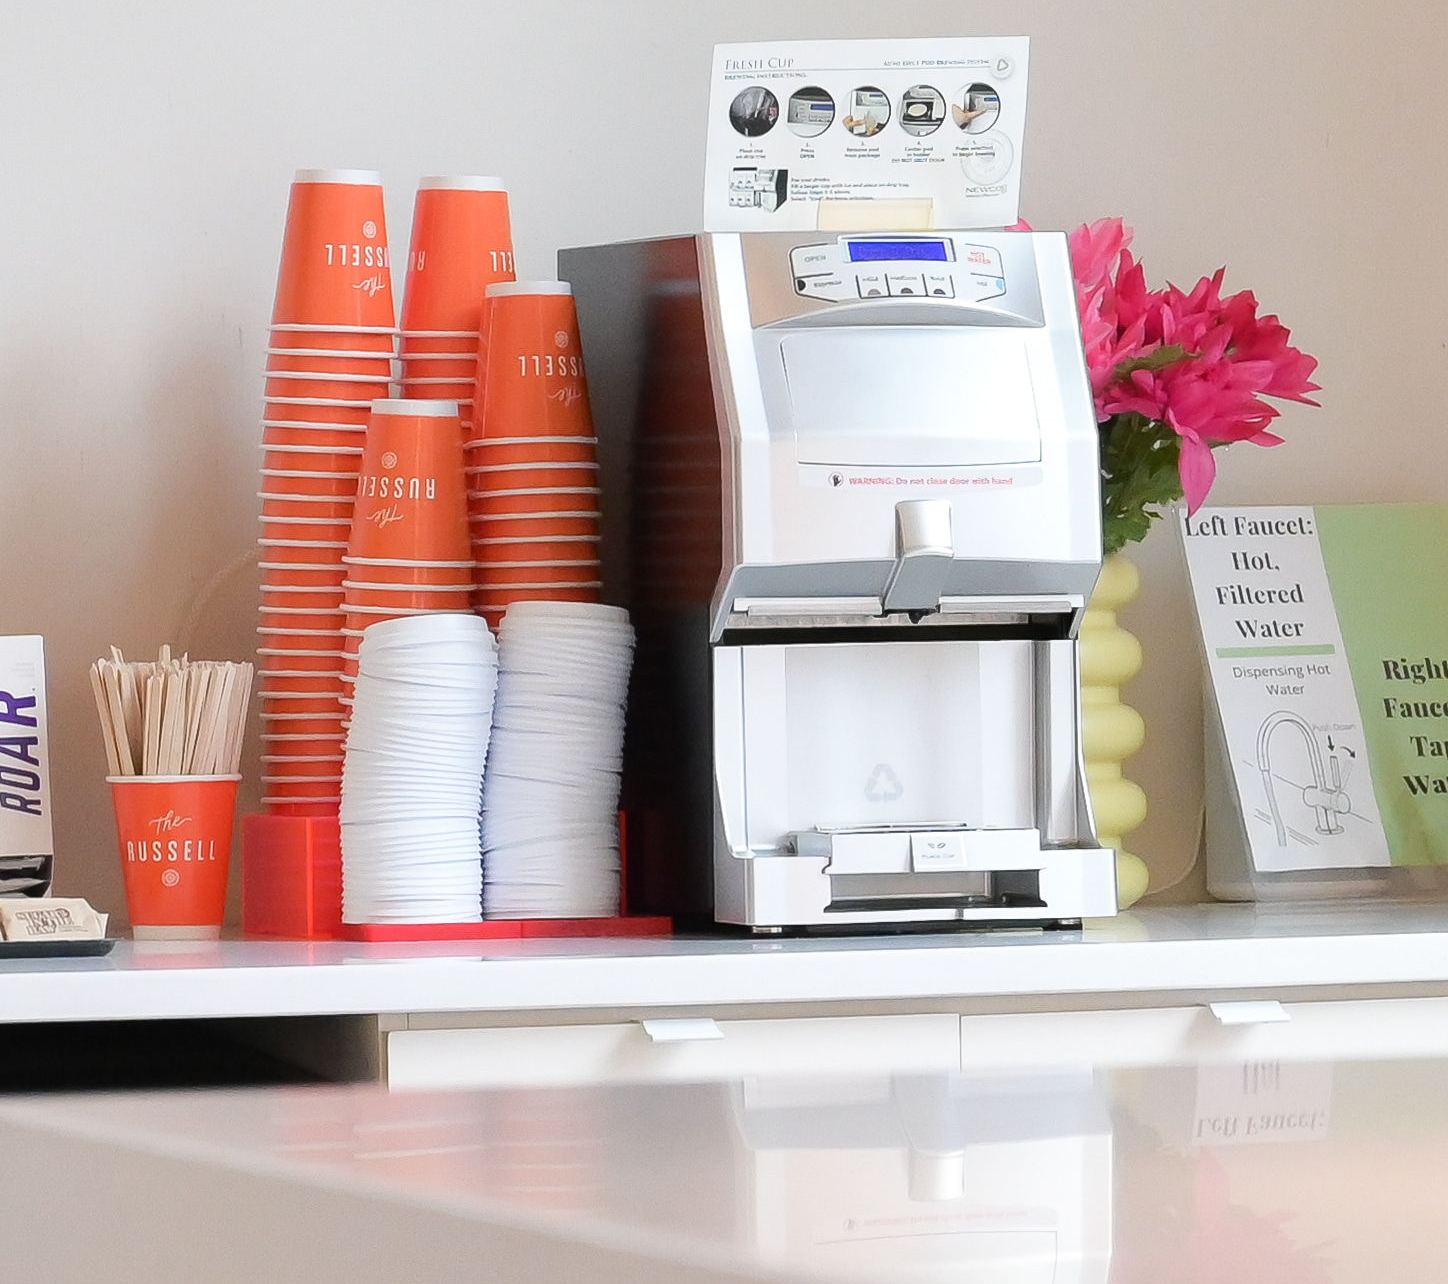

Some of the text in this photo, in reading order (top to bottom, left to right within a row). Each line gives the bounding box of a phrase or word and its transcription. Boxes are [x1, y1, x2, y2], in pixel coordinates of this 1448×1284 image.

[352, 272, 386, 297] The
[895, 477, 909, 485] Do
[926, 477, 948, 485] close
[949, 477, 970, 486] door
[971, 477, 990, 485] with
[366, 503, 405, 529] The
[1184, 515, 1314, 537] Left Faucet:
[1215, 583, 1305, 605] Filtered
[1235, 619, 1305, 639] Water
[1232, 663, 1332, 681] Dispensing Hot
[1265, 684, 1305, 696] Water
[148, 809, 193, 836] The
[127, 839, 216, 862] RUSSELL
